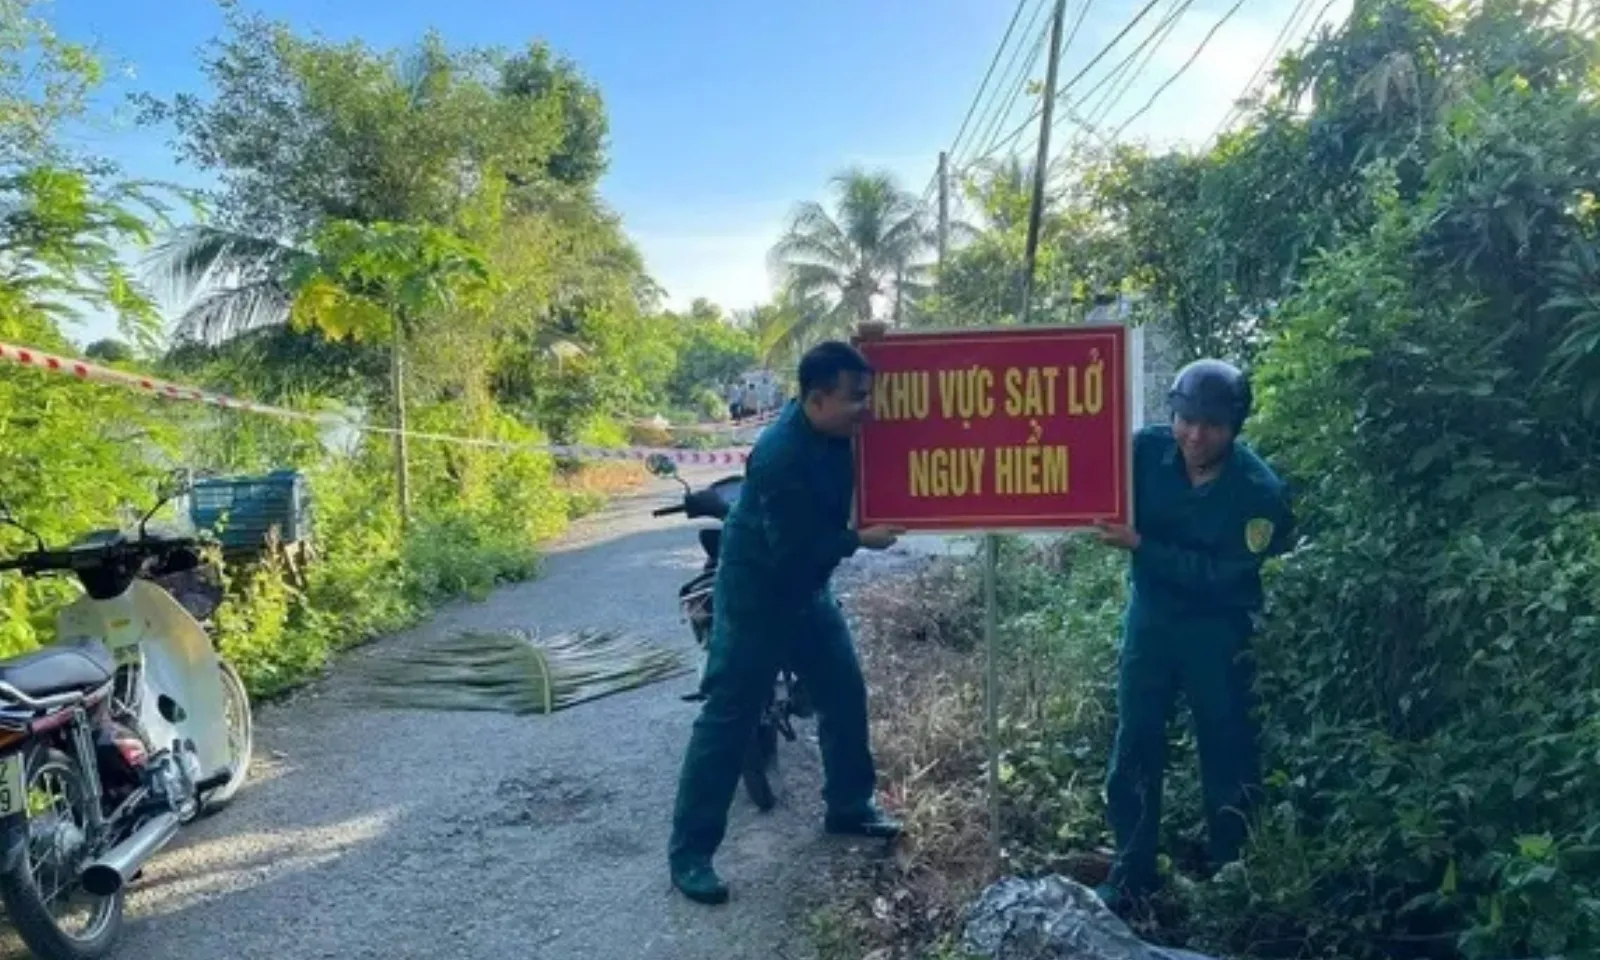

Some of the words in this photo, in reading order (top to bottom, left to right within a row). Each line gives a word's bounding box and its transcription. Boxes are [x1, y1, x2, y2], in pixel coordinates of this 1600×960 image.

[872, 370, 930, 420] KHU
[938, 364, 994, 429] VỰC
[1005, 366, 1060, 427] SẠT
[1067, 347, 1104, 416] LỞ
[908, 448, 985, 497] NGUY
[994, 426, 1069, 494] HIỂM
